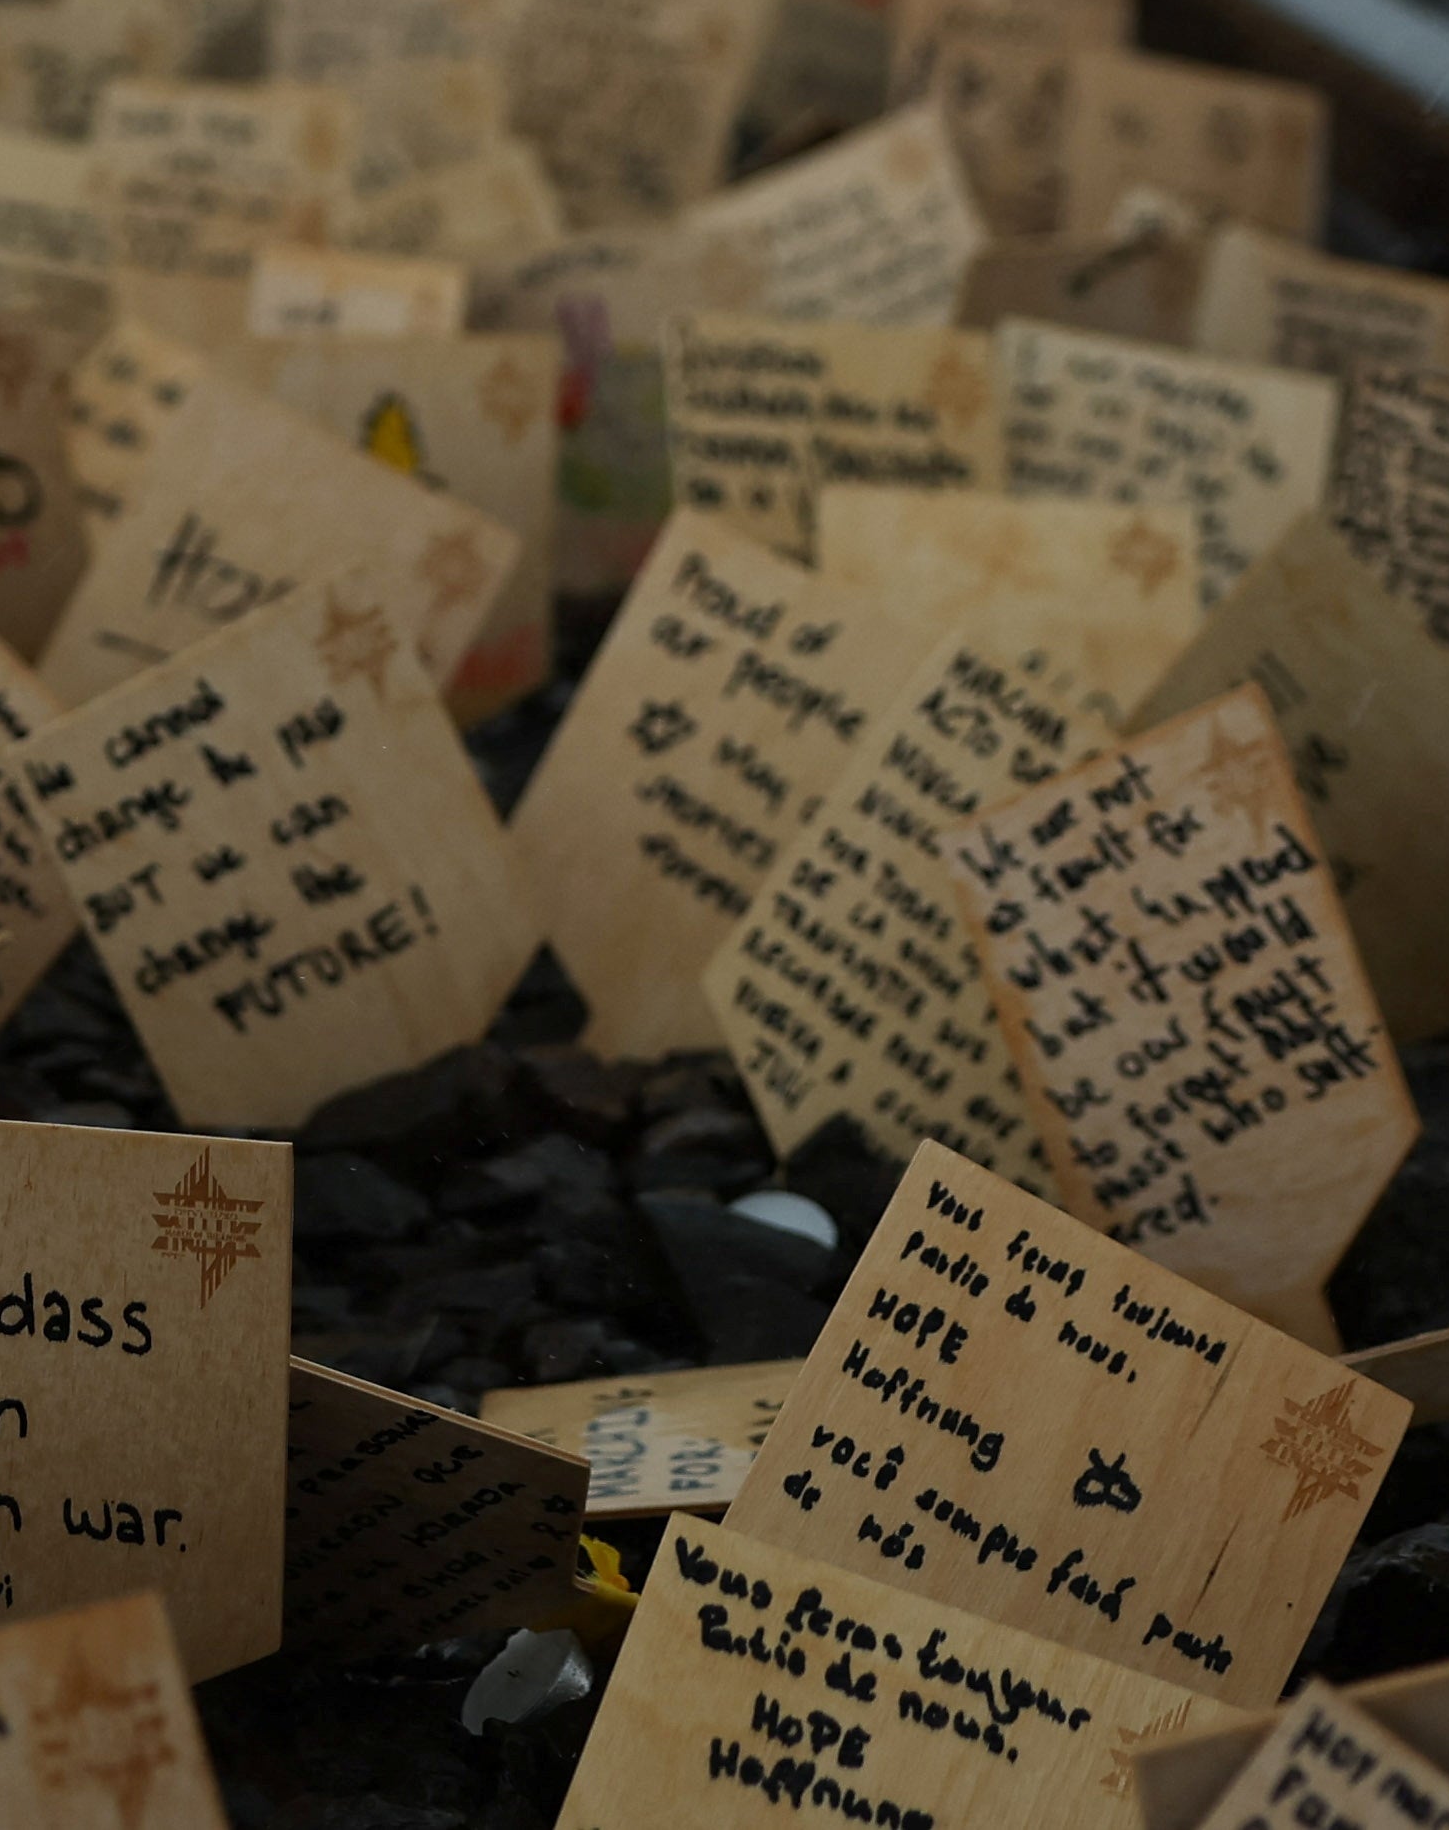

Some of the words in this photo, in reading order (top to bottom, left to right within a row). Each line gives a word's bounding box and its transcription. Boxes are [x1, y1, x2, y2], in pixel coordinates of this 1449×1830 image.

[866, 1287, 970, 1367] HOPE
[842, 1338, 1007, 1474] Hoffnung
[62, 1496, 190, 1554] war.
[825, 1652, 878, 1705] de
